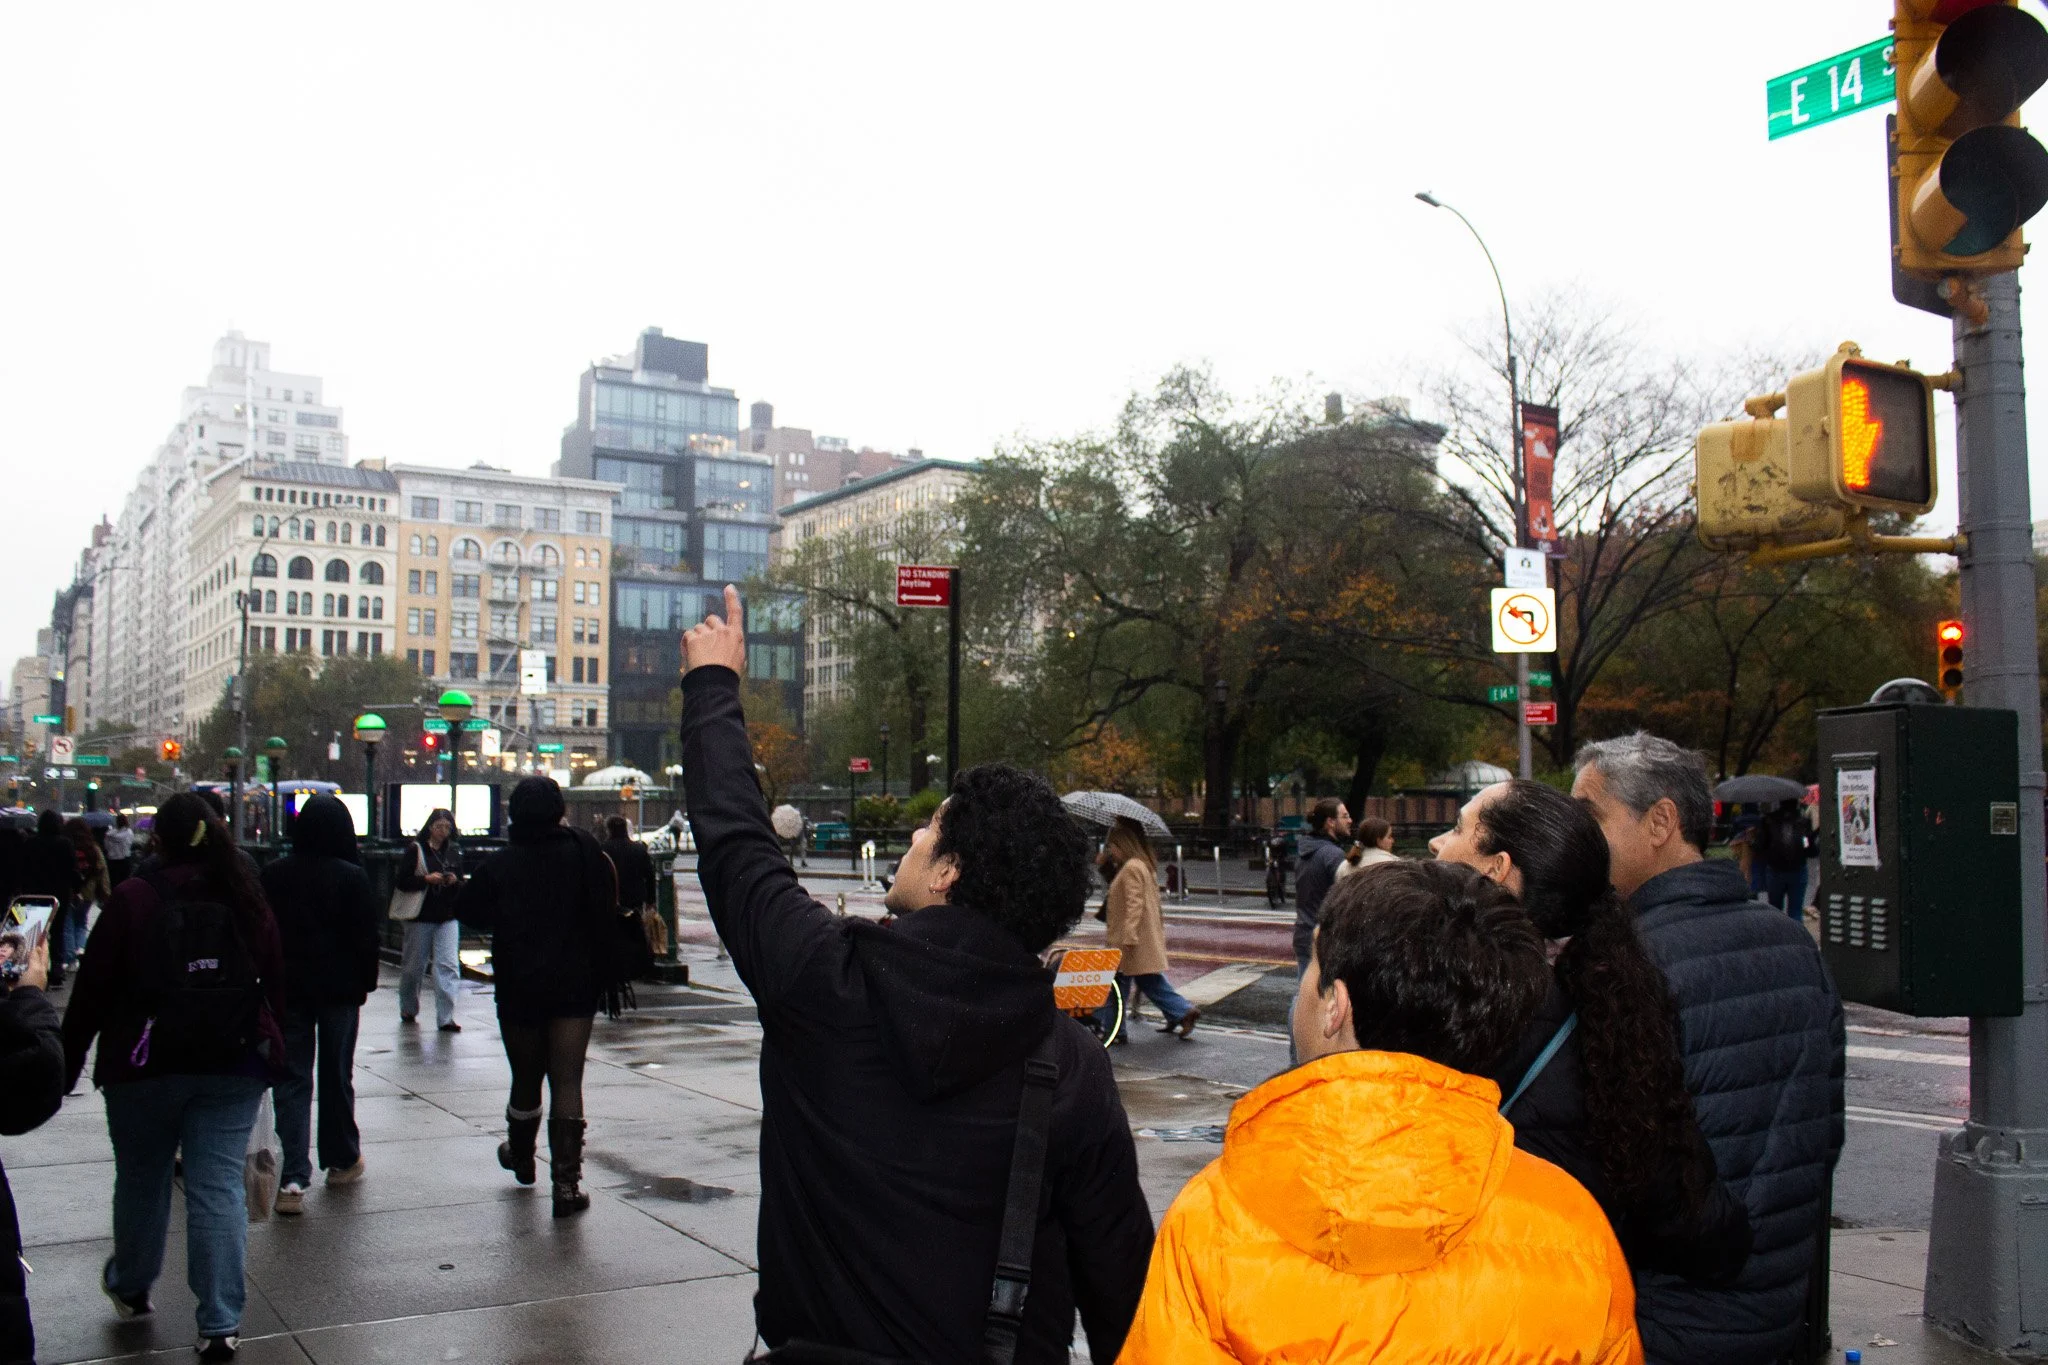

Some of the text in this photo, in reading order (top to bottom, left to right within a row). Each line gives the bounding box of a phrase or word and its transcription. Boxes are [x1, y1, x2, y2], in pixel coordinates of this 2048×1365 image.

[1791, 76, 1810, 126] E
[1827, 57, 1863, 112] 14
[900, 569, 950, 579] NO STANDING
[188, 959, 219, 972] NYU
[1070, 974, 1102, 983] JOCO
